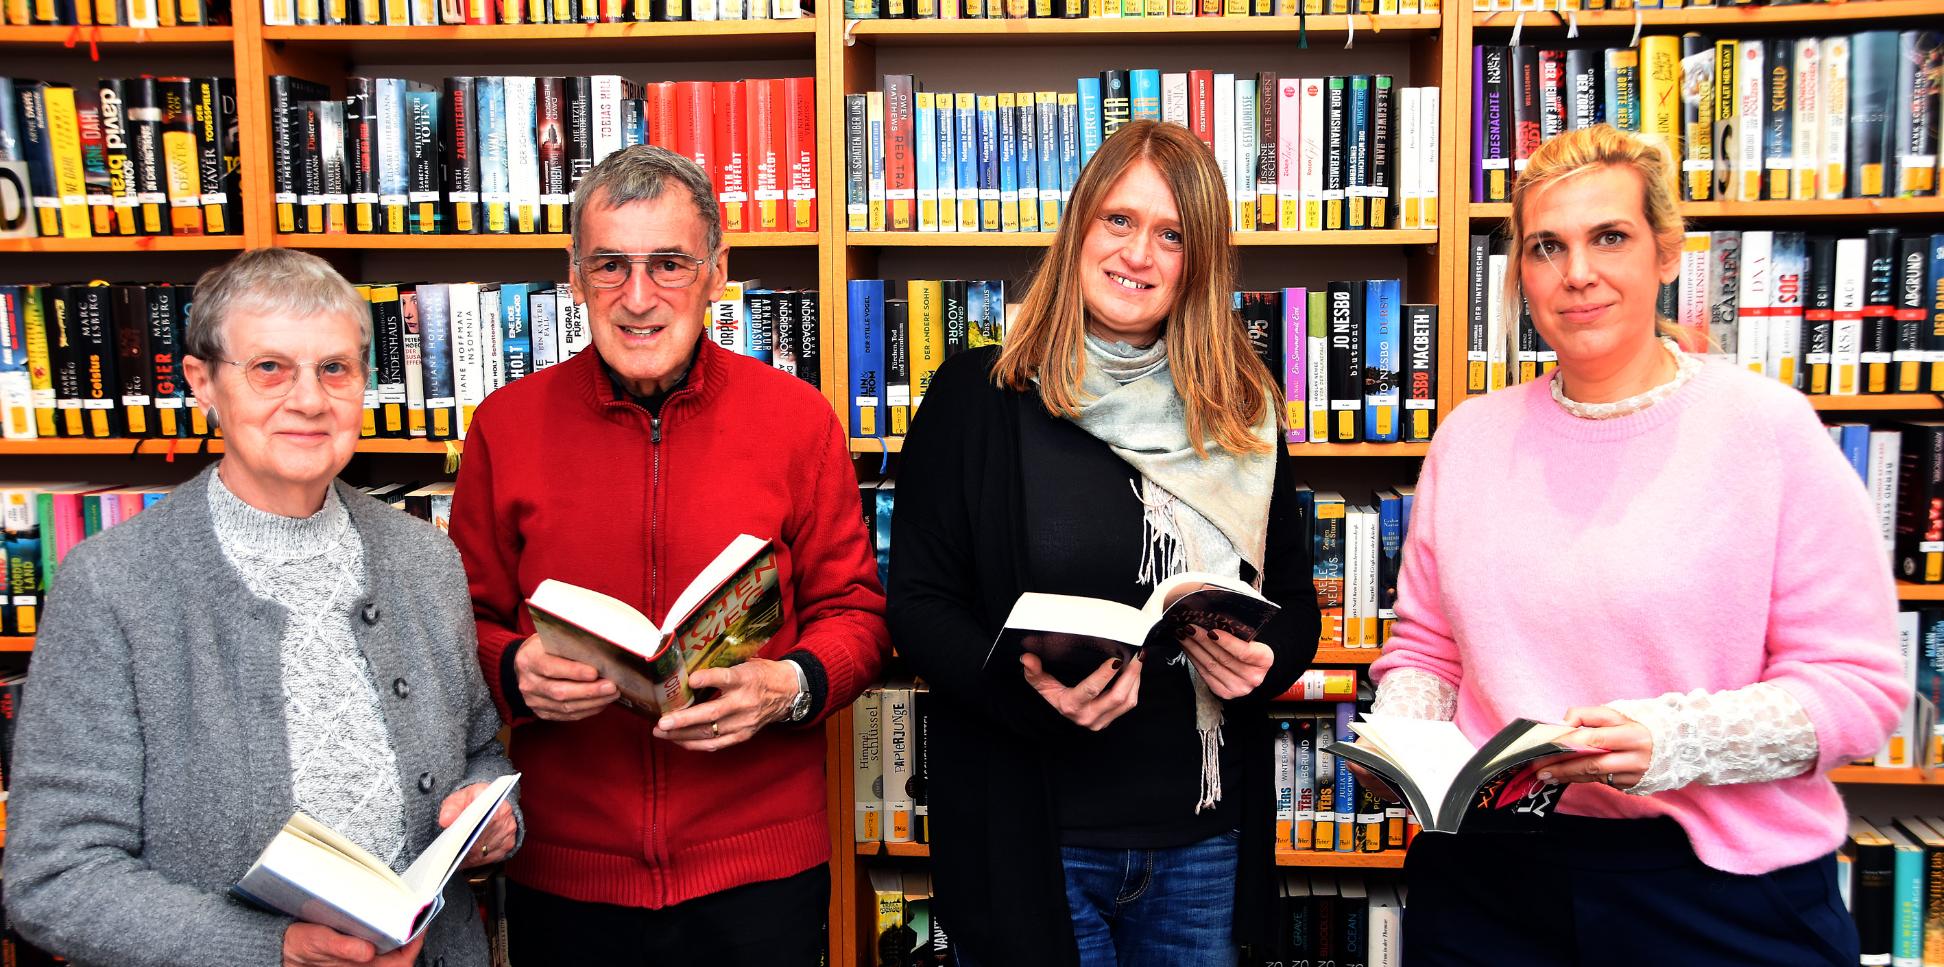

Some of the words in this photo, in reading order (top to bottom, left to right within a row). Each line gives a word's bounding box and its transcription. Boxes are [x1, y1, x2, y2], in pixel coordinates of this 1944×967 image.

[1491, 52, 1501, 84] ROSE
[1544, 62, 1557, 78] DER
[1721, 48, 1731, 67] STAY
[600, 79, 611, 100] HILL
[1576, 75, 1589, 92] DER
[1616, 77, 1628, 104] DRITTE
[1721, 68, 1731, 85] HER
[1771, 65, 1788, 112] SCHULD
[281, 91, 289, 115] NULL
[413, 97, 421, 113] DER
[579, 94, 587, 118] NAHT
[851, 100, 861, 115] UNS
[890, 83, 898, 131] MATTHEWS
[1331, 90, 1342, 107] ROR
[1545, 81, 1557, 111] NEUNTE
[1576, 93, 1589, 117] ZORN
[1721, 86, 1731, 99] LET
[81, 107, 101, 139] DAHL
[101, 88, 127, 148] david
[196, 104, 204, 121] DER
[200, 84, 215, 142] TODESSPIELER
[420, 103, 432, 146] TOTEN
[453, 89, 467, 160] ZARTBITTERTOD
[572, 100, 580, 128] LETZTE
[600, 104, 612, 138] TOBIAS
[1083, 92, 1098, 155] LEERGUT
[1378, 103, 1387, 139] SCHWERE
[1546, 114, 1557, 133] ARM
[1617, 106, 1628, 129] HERZ
[282, 119, 290, 147] UNTER
[1330, 111, 1341, 146] MISHANI
[1358, 131, 1366, 143] DIE
[85, 144, 105, 174] ARNE
[852, 136, 862, 168] SCHATTEN
[895, 135, 905, 160] RED
[1376, 143, 1385, 165] HAND
[176, 142, 190, 191] DEAVER
[724, 164, 733, 172] &
[758, 163, 767, 171] &
[793, 162, 802, 171] &
[853, 170, 862, 182] DIE
[1474, 246, 1484, 304] TINTENFISCHER
[1720, 247, 1739, 325] GARTEN
[1751, 256, 1766, 293] DNA
[1777, 273, 1799, 303] SOG
[1904, 252, 1922, 308] ABGRUND
[78, 302, 90, 337] MARC
[87, 293, 103, 344] ELSBERG
[151, 303, 161, 337] MARC
[159, 294, 172, 345] ELSBERG
[434, 297, 445, 341] NEMESIS
[513, 295, 522, 315] MORD
[536, 303, 544, 334] KALTER
[564, 306, 573, 329] GRAB
[982, 289, 990, 321] Seehaus
[1333, 292, 1350, 333] NESBØ
[1378, 295, 1389, 336] DURST
[1474, 306, 1482, 321] DER
[1711, 303, 1721, 324] DER
[456, 310, 466, 362] HOFFMAN
[507, 322, 516, 339] EINE
[514, 315, 522, 332] VON
[565, 330, 573, 344] EIN
[572, 320, 582, 338] FÜR
[720, 304, 734, 346] ORPHAN
[762, 299, 772, 351] ARNALDUR
[891, 330, 899, 342] Tod
[923, 312, 931, 343] ANDERE
[948, 298, 958, 345] MOORE
[982, 322, 990, 337] Das
[464, 310, 475, 365] INSOMNIA
[537, 337, 545, 351] EIN
[864, 341, 872, 353] DER
[897, 322, 906, 363] Tannenbaum
[1333, 336, 1350, 350] JO
[1350, 323, 1359, 376] blutmond
[1412, 314, 1430, 369] MACBETH
[510, 345, 525, 378] HOLT
[1378, 341, 1389, 380] NESBØ
[61, 368, 71, 394] MARC
[89, 354, 103, 399] Celsius
[22, 561, 36, 590] LAND
[1318, 569, 1328, 595] NELE
[1327, 556, 1339, 607] NEUHAUS
[865, 706, 879, 761] schlüssel
[858, 732, 869, 770] Himmel
[1281, 733, 1289, 782] WINTERMORD
[1301, 740, 1310, 784] ABGRUND
[1293, 911, 1302, 946] GRAVE
[1347, 912, 1357, 953] OCEAN
